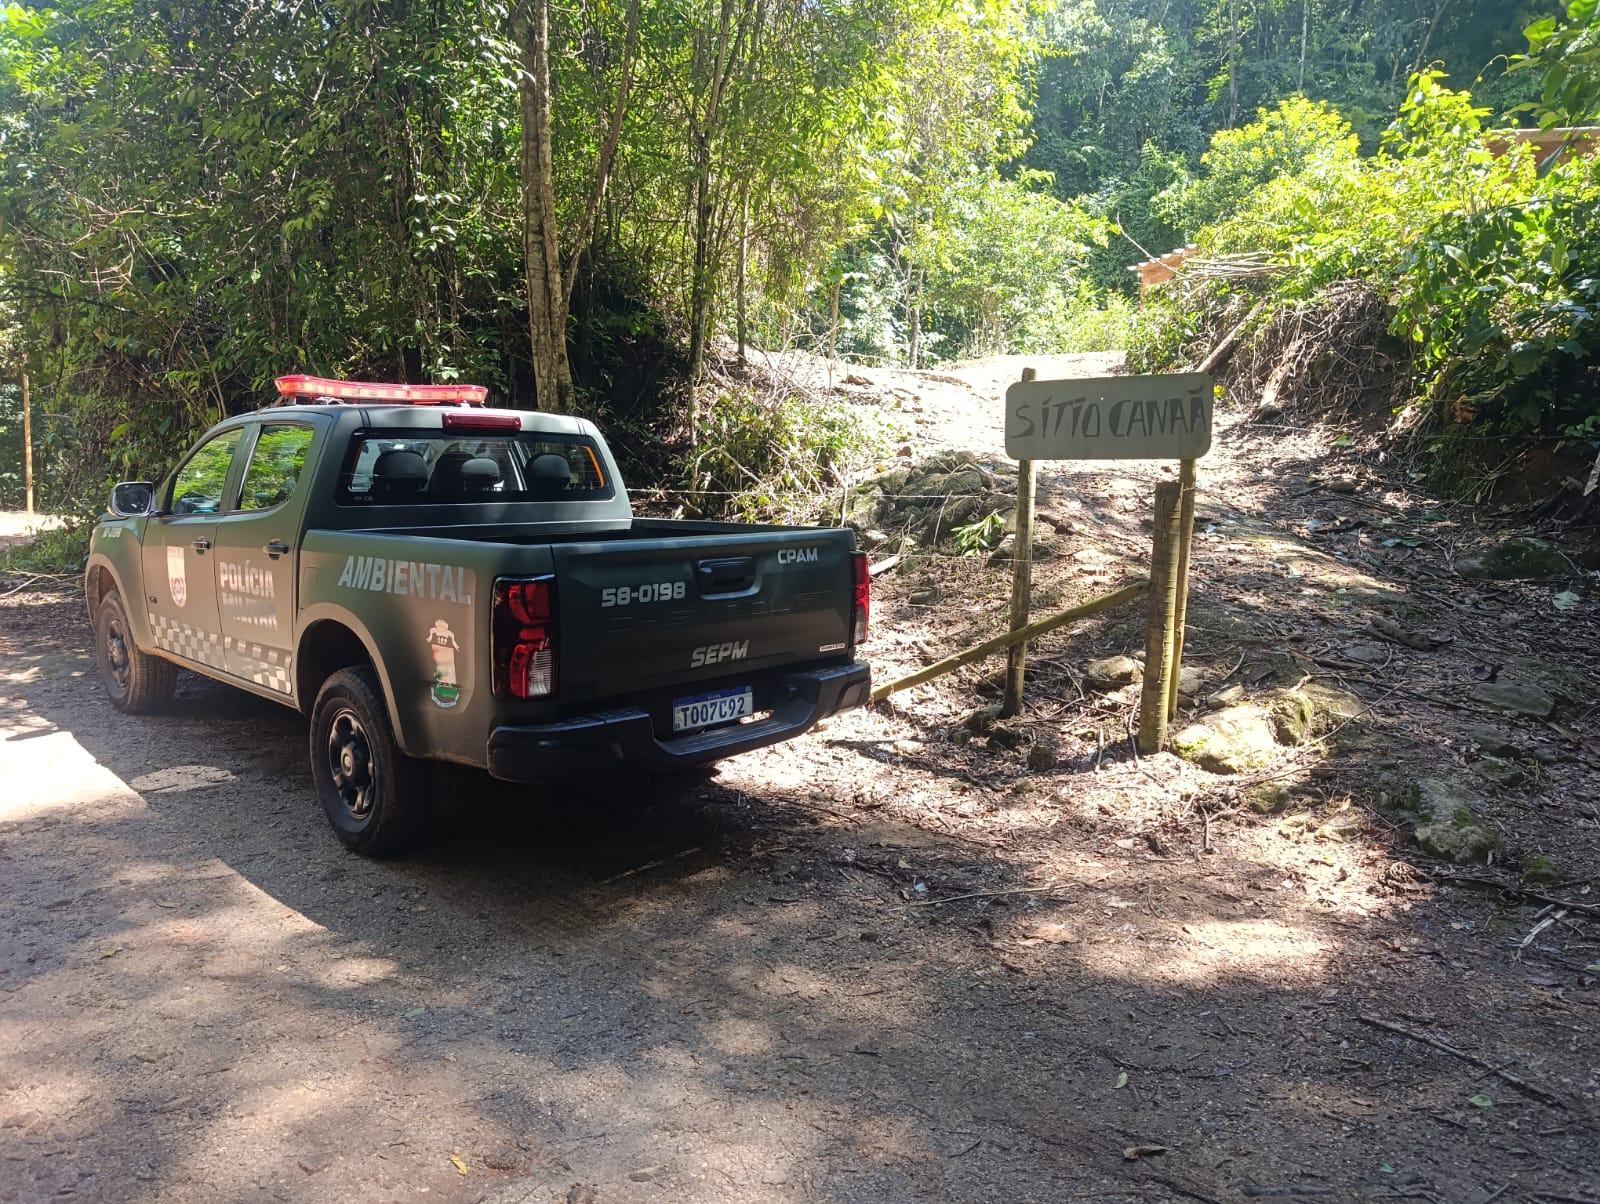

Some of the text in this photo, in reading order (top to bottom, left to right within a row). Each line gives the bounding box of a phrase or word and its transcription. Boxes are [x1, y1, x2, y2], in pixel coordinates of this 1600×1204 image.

[777, 547, 819, 565] CPAM
[219, 560, 276, 599] POLÍCIA
[338, 555, 472, 605] AMBIENTAL
[601, 581, 687, 608] 58-0198
[690, 639, 750, 668] SEPM
